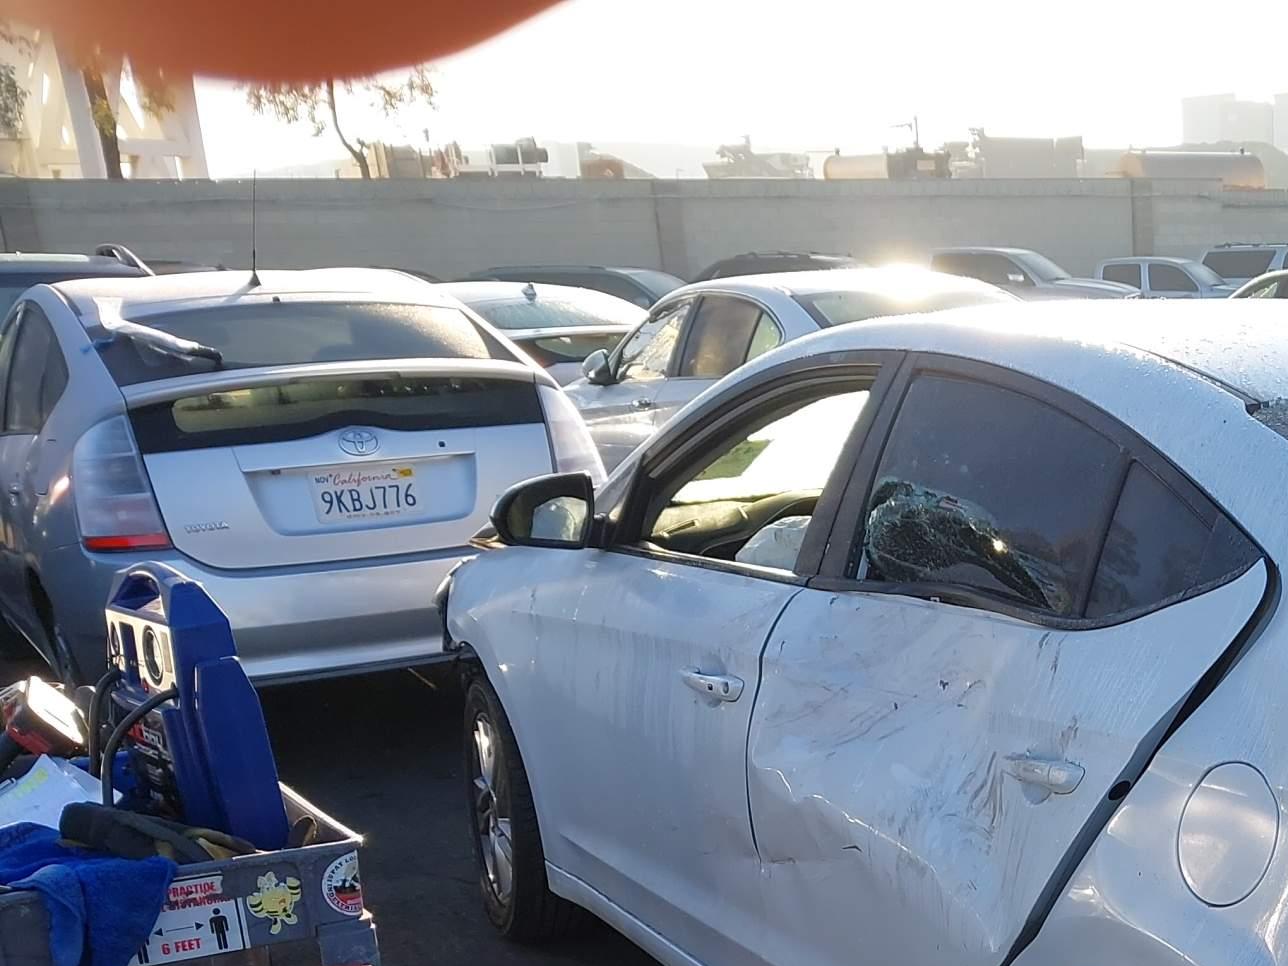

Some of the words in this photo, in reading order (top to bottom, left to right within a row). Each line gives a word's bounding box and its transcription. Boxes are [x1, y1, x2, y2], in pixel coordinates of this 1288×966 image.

[315, 476, 329, 484] NOV
[332, 469, 399, 487] California
[320, 483, 417, 515] 9KBJ776
[184, 521, 230, 534] TOYOTA
[161, 940, 171, 955] 6
[174, 937, 202, 953] FEET
